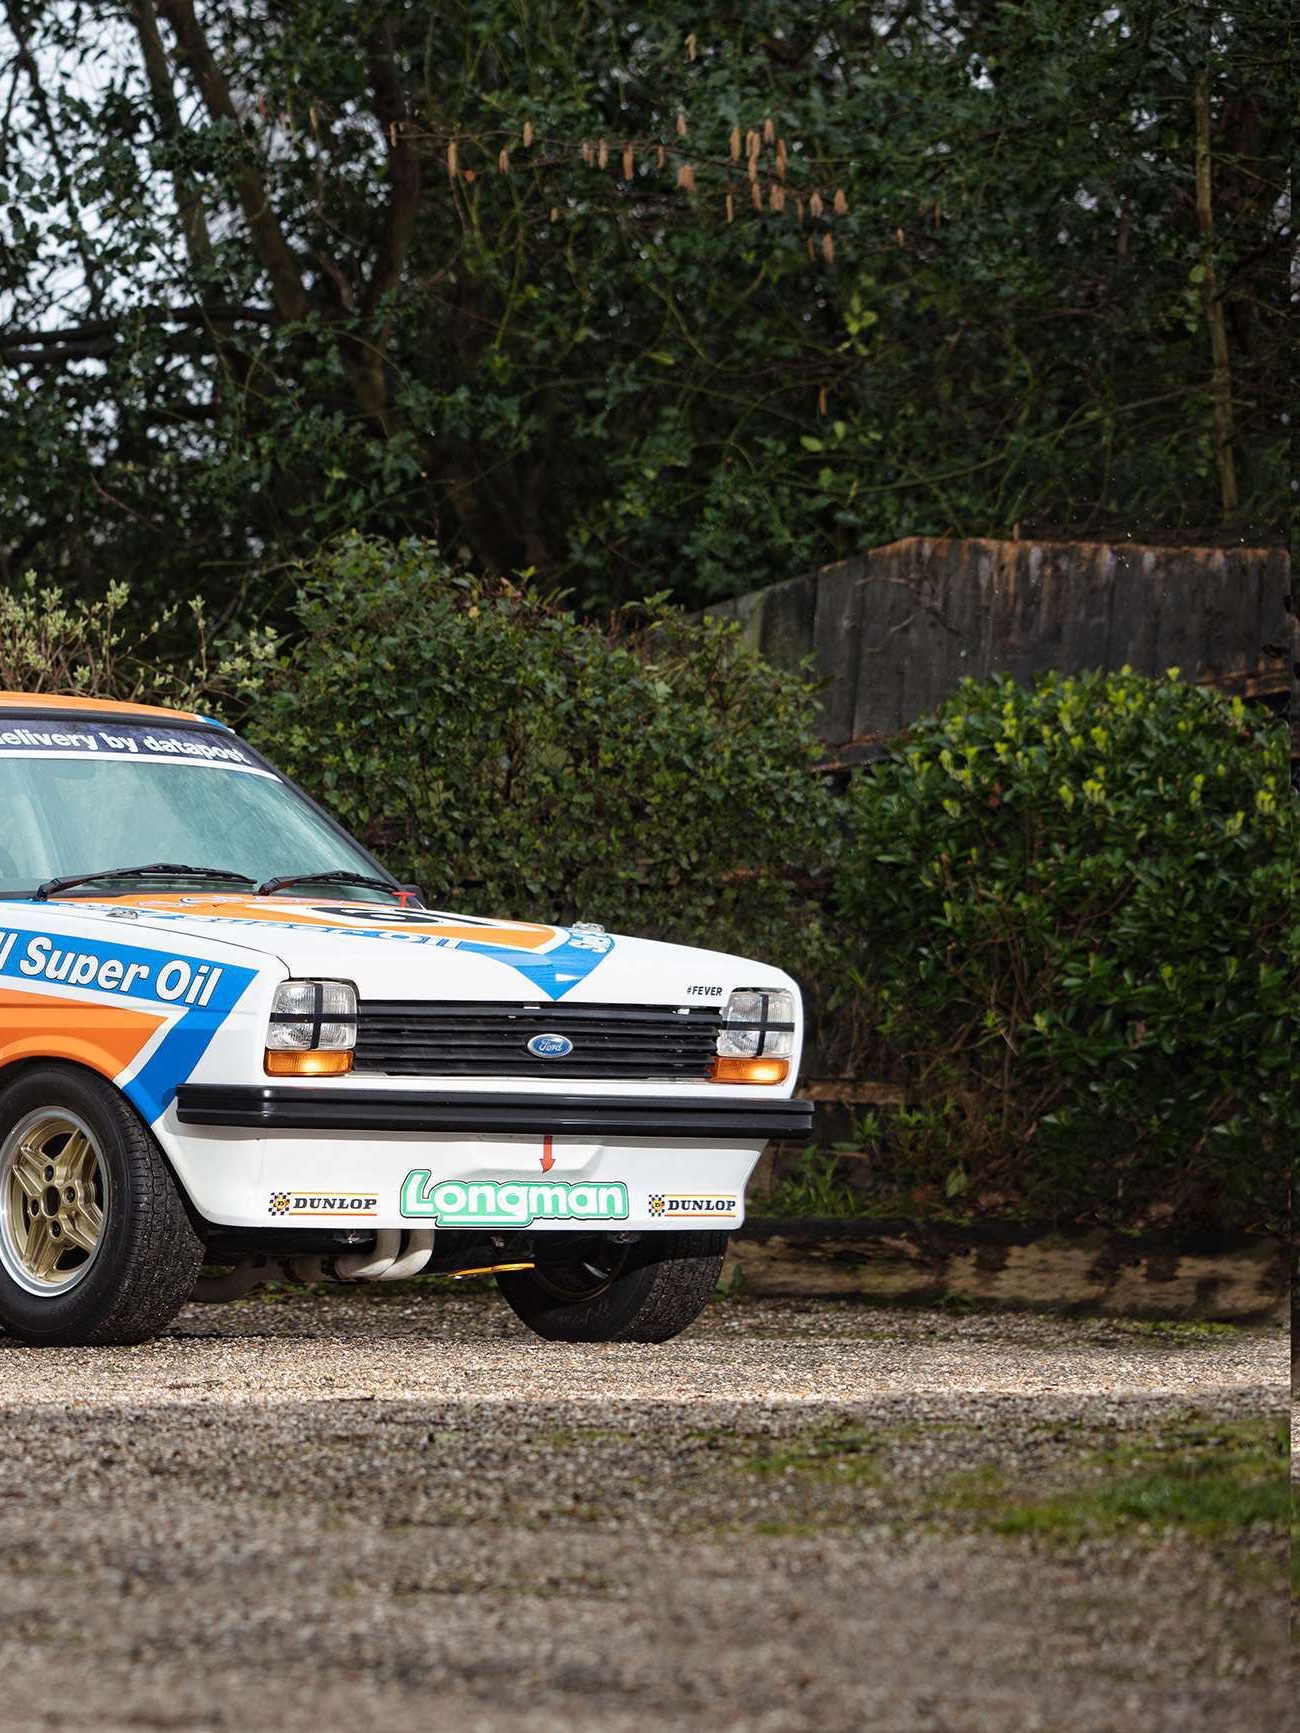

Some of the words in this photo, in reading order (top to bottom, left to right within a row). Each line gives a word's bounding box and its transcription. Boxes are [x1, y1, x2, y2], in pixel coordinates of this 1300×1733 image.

[99, 732, 139, 753] by
[143, 735, 251, 765] datapost
[19, 935, 150, 992] Super
[155, 960, 224, 1008] Oil
[686, 985, 723, 997] #FEVER
[539, 1039, 563, 1051] Ford
[293, 1198, 377, 1211] DUNLOP
[402, 1170, 628, 1227] Longman
[667, 1200, 736, 1211] DUNLOP
